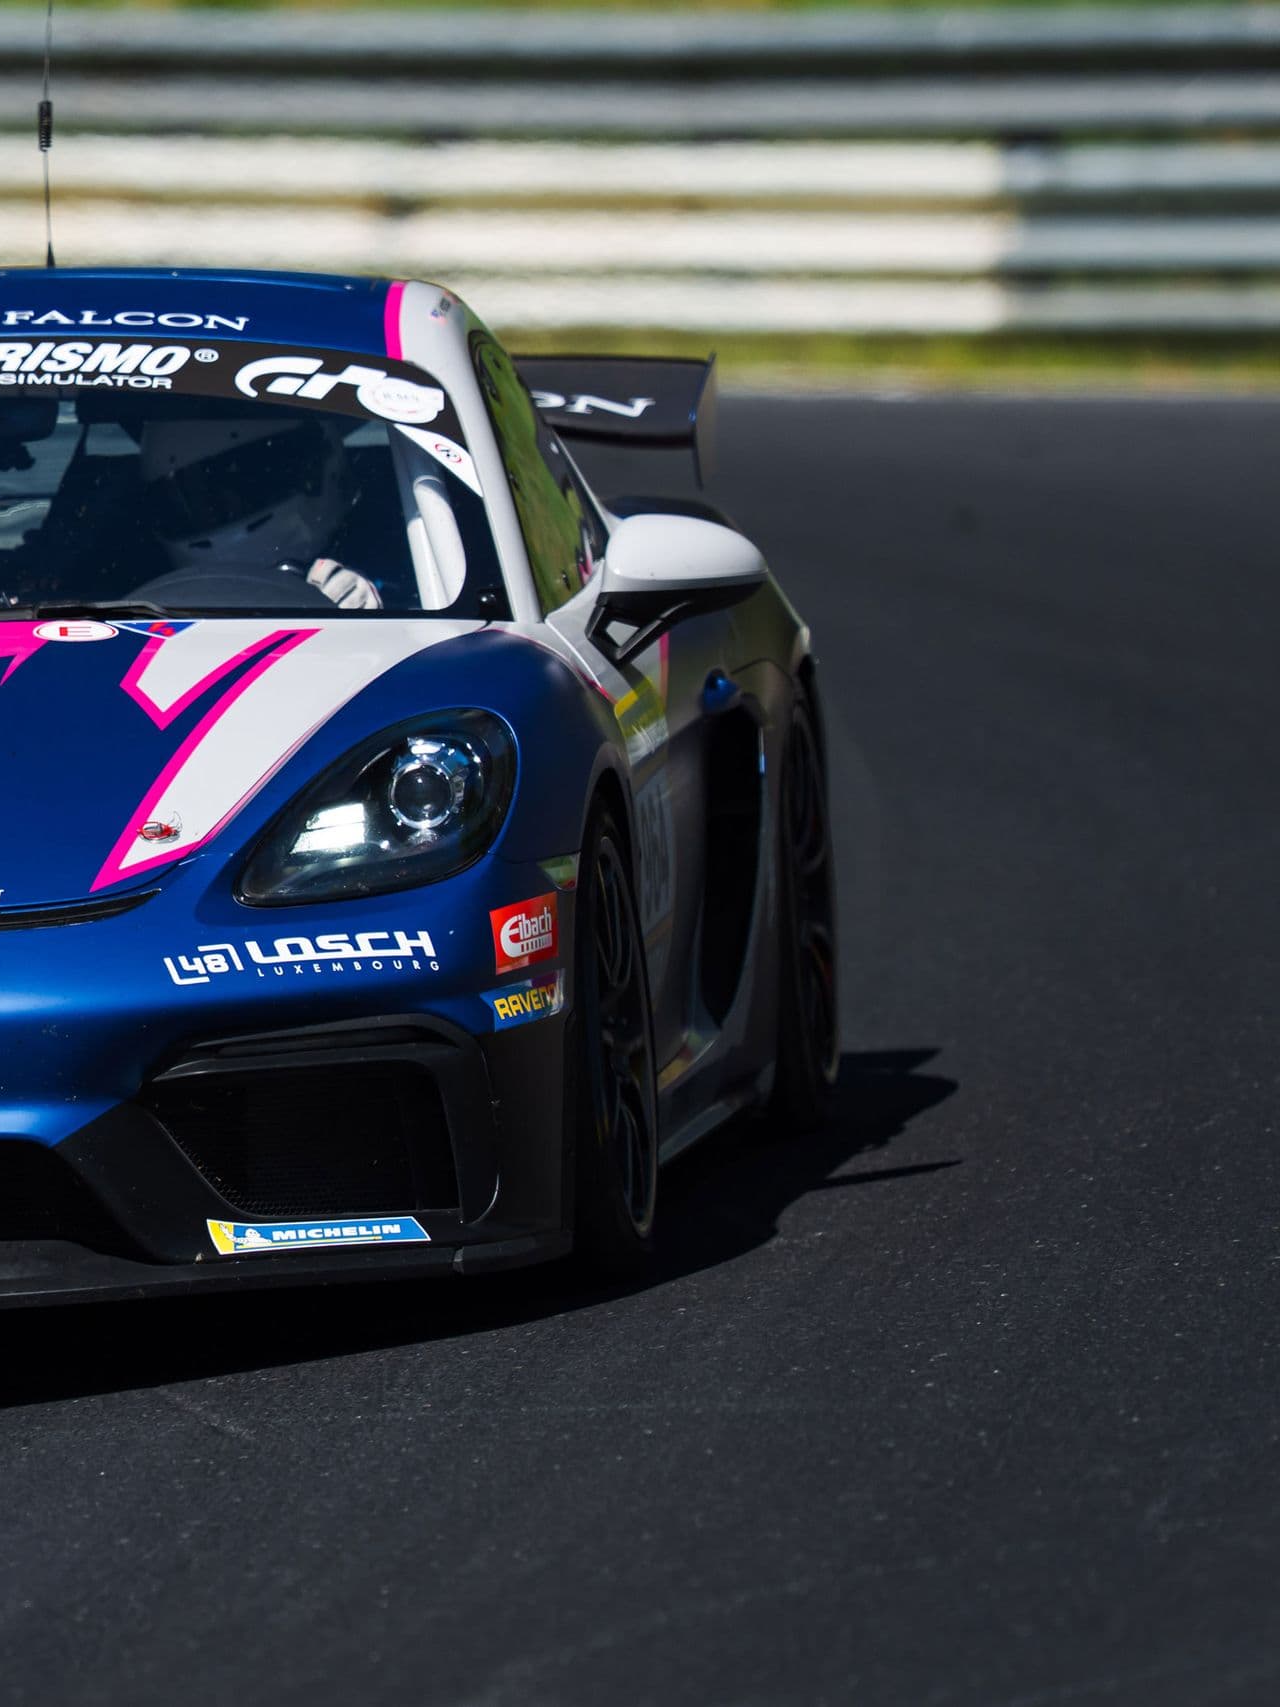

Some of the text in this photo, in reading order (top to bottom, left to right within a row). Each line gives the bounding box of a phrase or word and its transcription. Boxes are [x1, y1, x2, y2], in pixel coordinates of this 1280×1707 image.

[2, 309, 250, 332] FALCON
[500, 906, 552, 958] Eibach
[245, 930, 437, 964] LOSCH
[256, 959, 440, 978] LUXEMBOURG
[271, 1223, 401, 1242] MICHELIN
